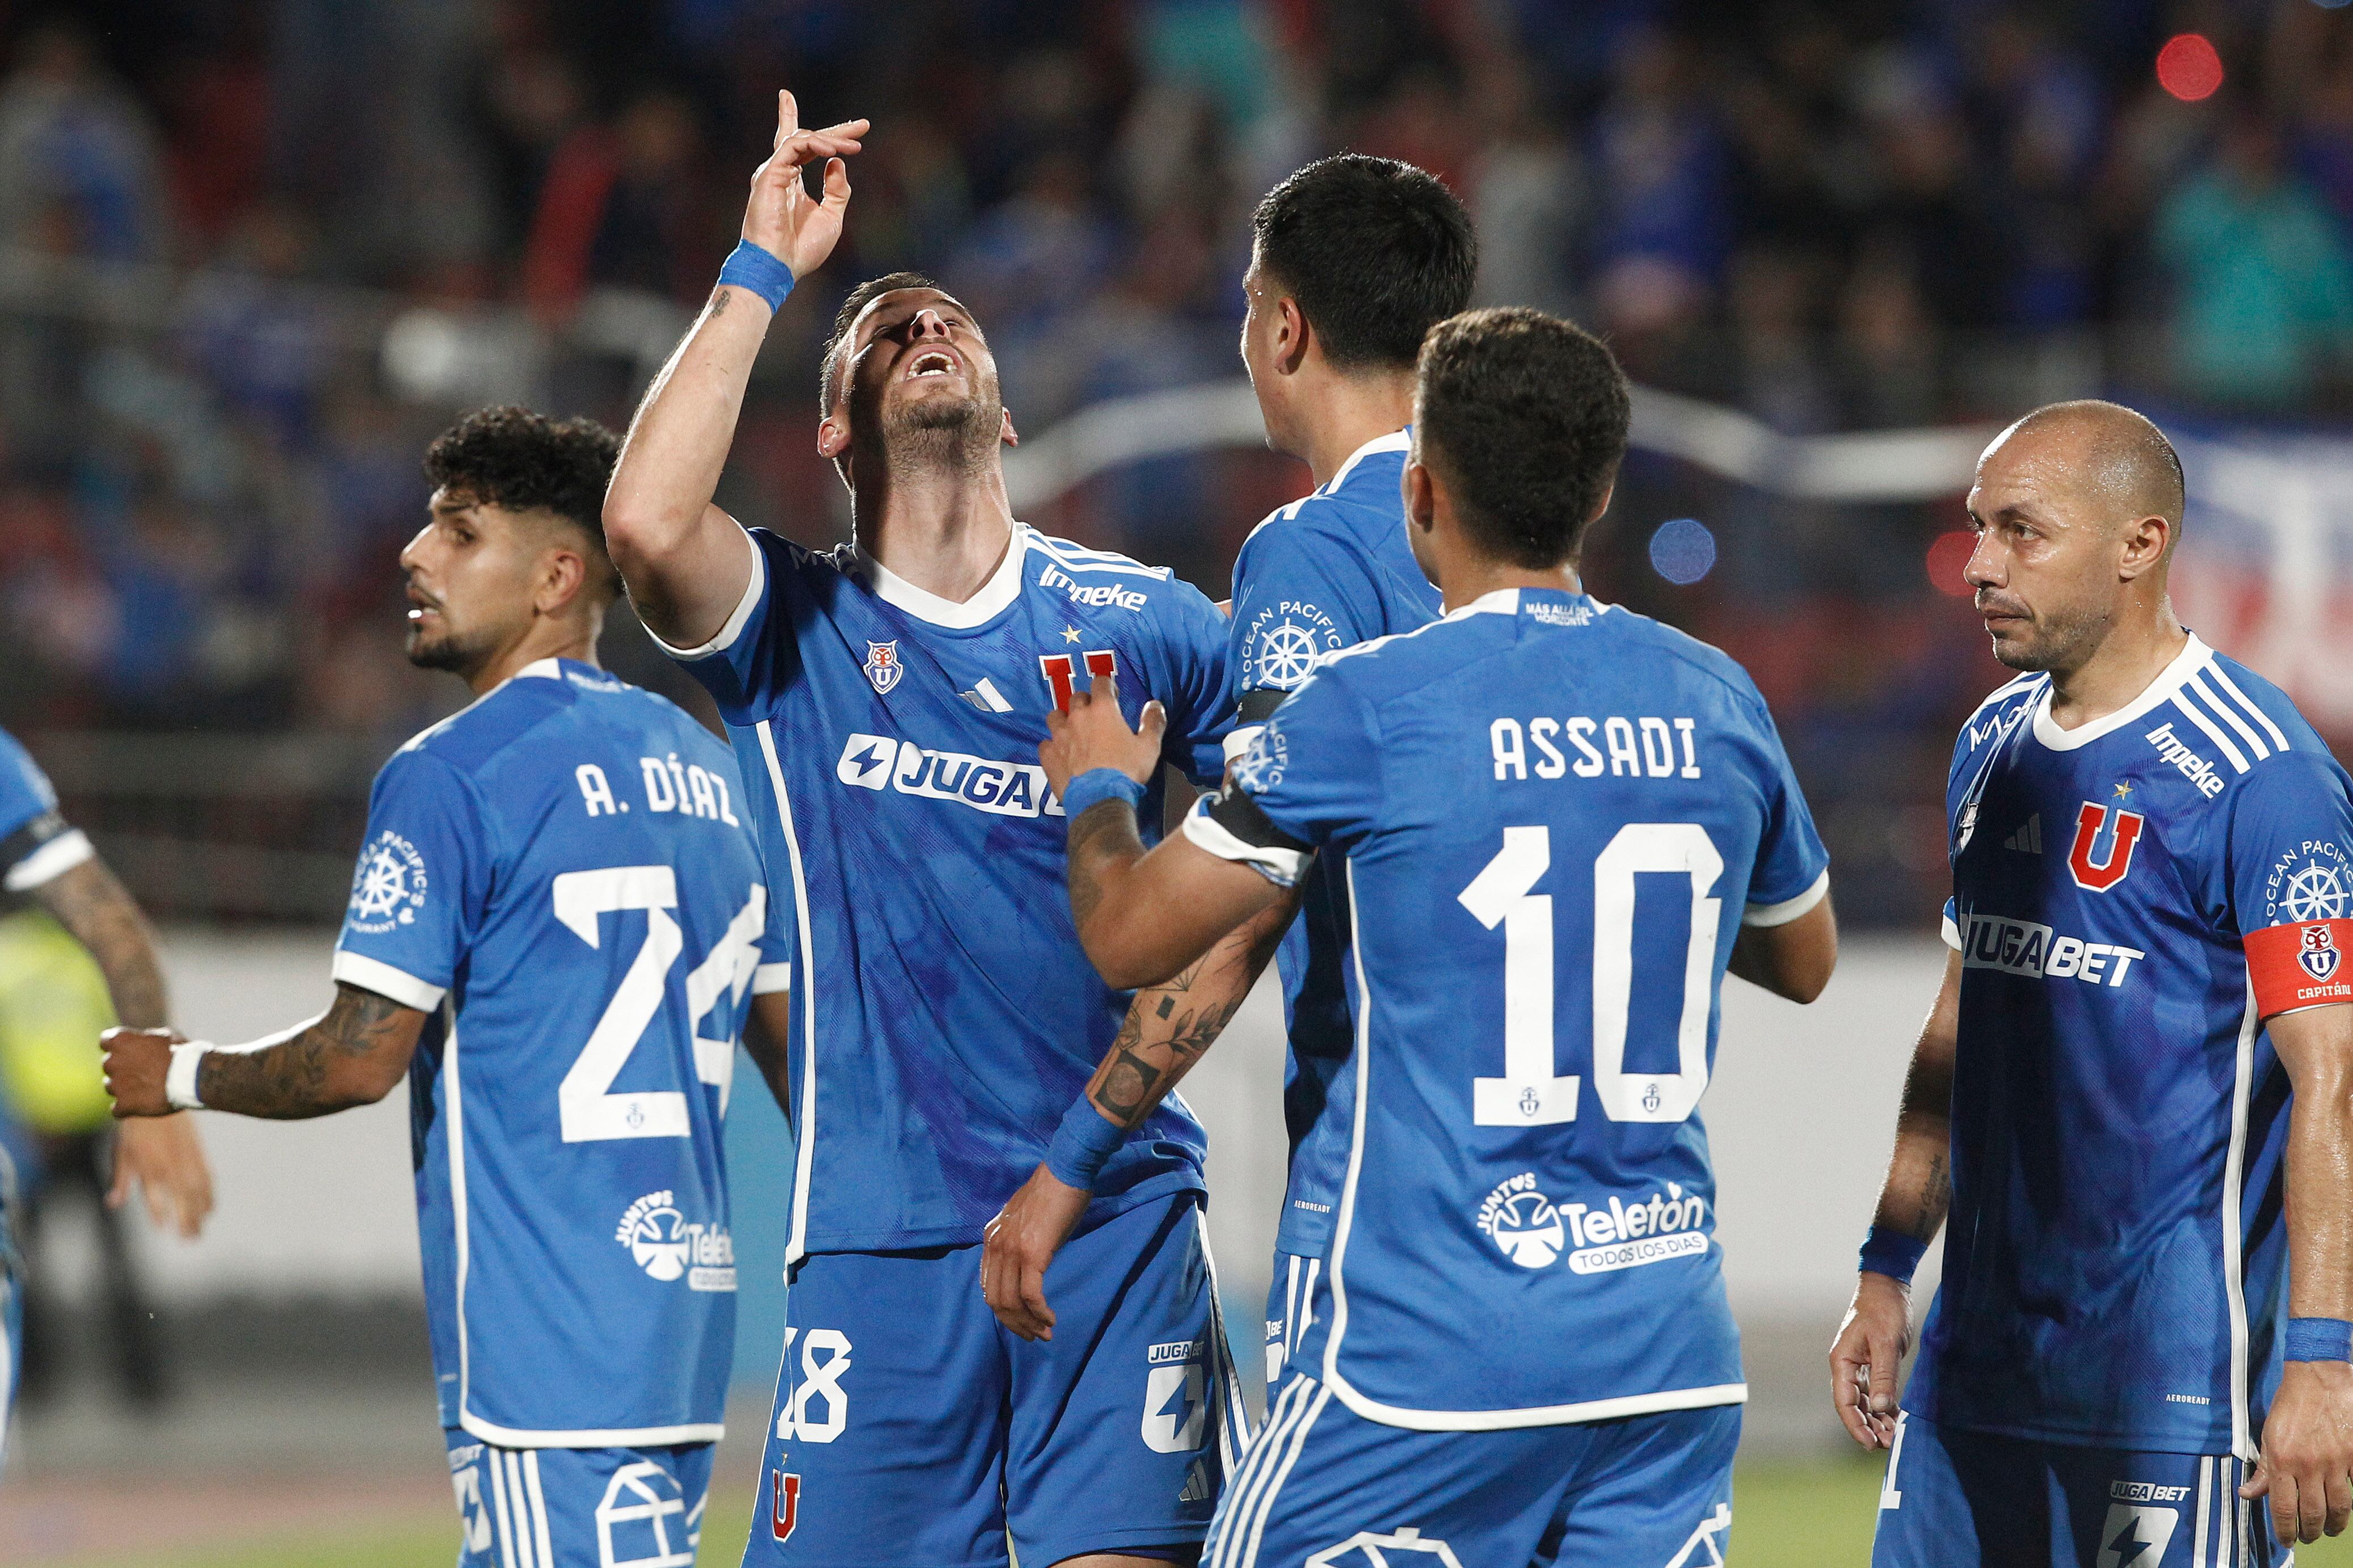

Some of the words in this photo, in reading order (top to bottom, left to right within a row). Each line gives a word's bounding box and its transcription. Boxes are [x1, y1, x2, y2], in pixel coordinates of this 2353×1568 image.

[1039, 563, 1147, 612] Impeke
[1241, 607, 1274, 673] OCEAN
[1489, 716, 1702, 781] ASSADI
[2145, 722, 2225, 799] Impeke
[575, 763, 630, 817] A.
[639, 752, 740, 828] DÍAZ
[901, 752, 1067, 817] JUGA
[2066, 800, 2145, 893] U
[2266, 848, 2298, 917] OCEAN
[553, 865, 766, 1143] 24
[1457, 823, 1724, 1126] 10
[2297, 981, 2352, 1000] CAPITÁN
[1294, 1200, 1331, 1213] AEROREADY
[1578, 1247, 1634, 1268] TODOS
[1636, 1241, 1666, 1259] LOS
[2166, 1393, 2211, 1406] AEROREADY
[2112, 1482, 2192, 1502] JUGABET
